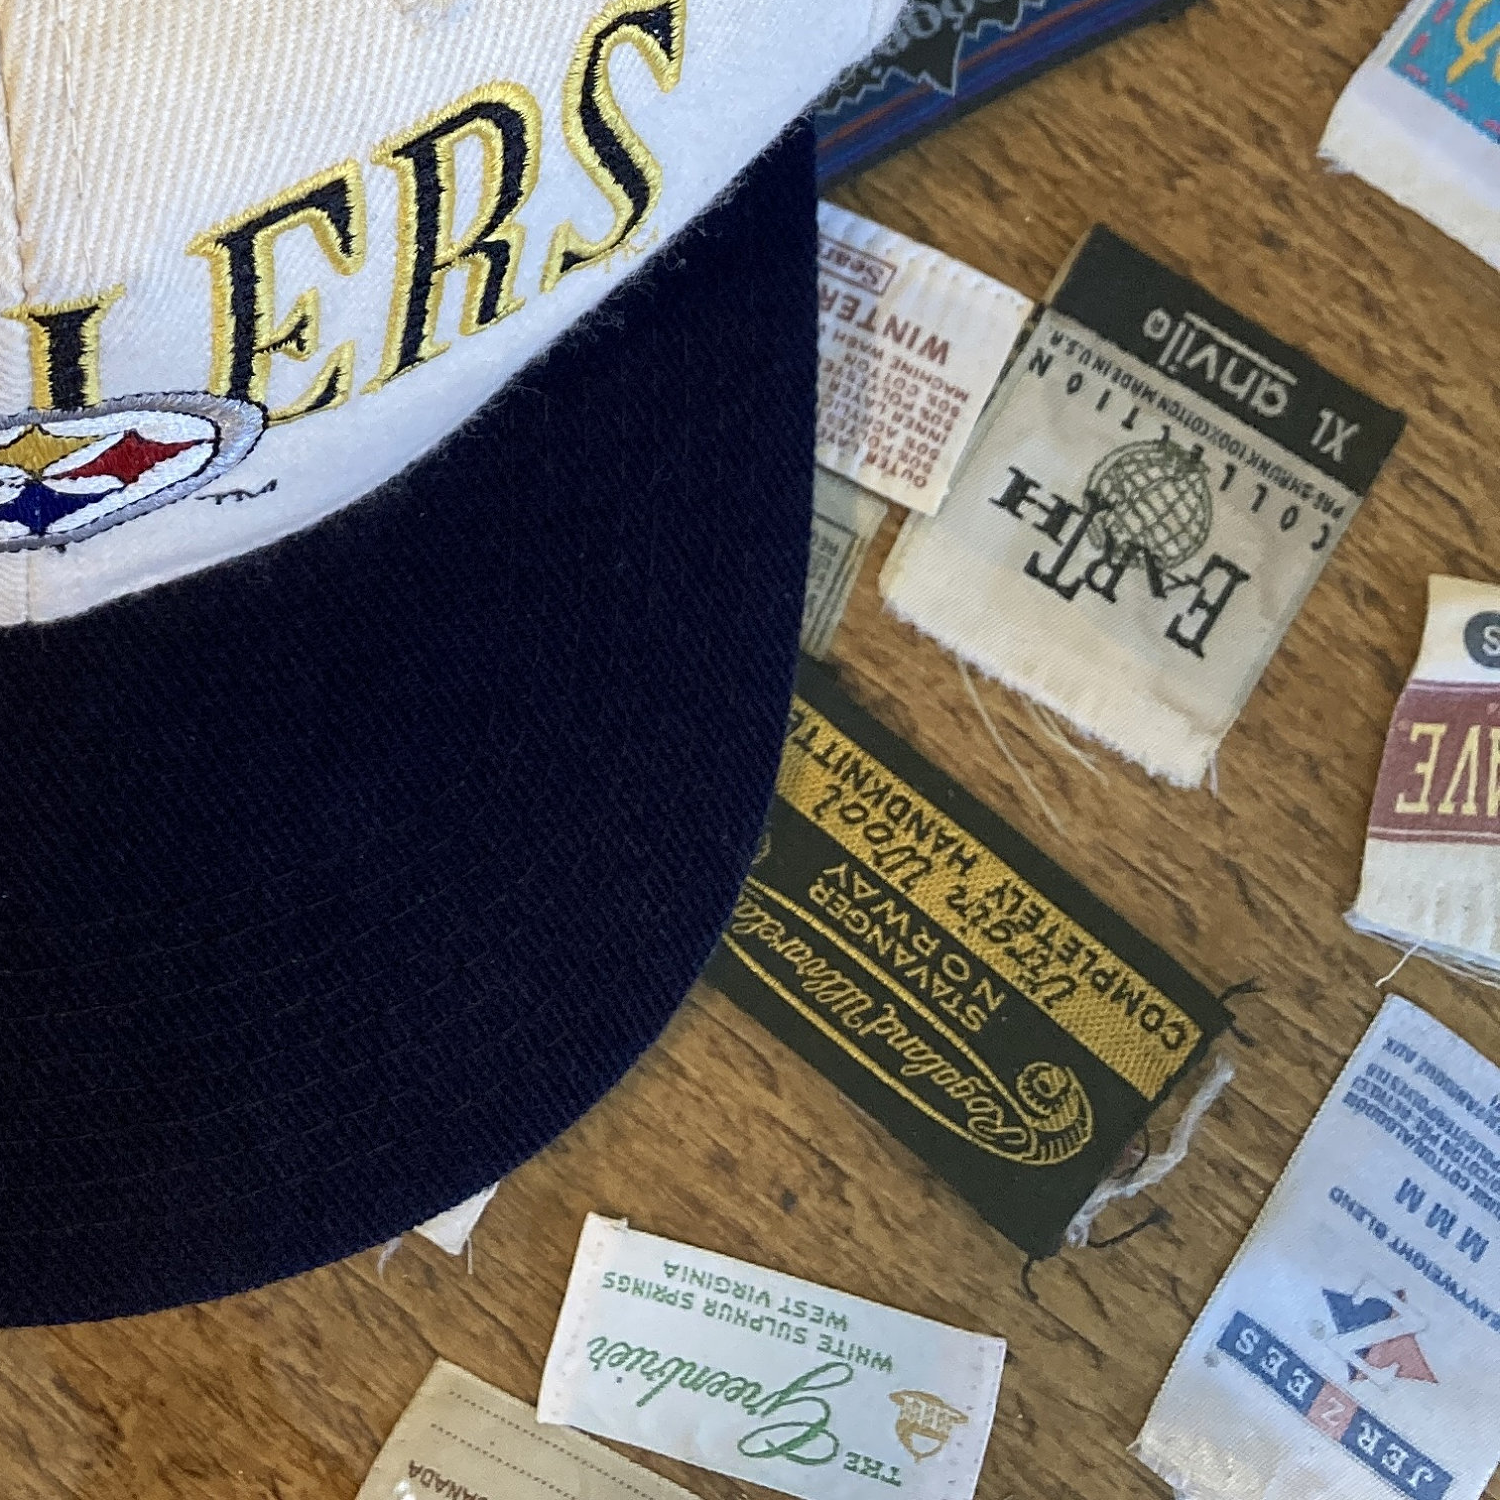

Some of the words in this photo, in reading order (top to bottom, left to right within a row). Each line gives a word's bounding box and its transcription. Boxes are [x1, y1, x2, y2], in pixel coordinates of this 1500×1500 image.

[816, 282, 952, 366] WINTER
[831, 327, 885, 362] WASH
[826, 378, 887, 416] LAYER
[841, 351, 920, 398] COTTON
[888, 354, 970, 403] MACHINE
[1107, 364, 1159, 404] MADE
[1156, 320, 1293, 424] anvil
[889, 410, 948, 445] INNER
[1026, 347, 1334, 553] COLLECTION
[1302, 404, 1361, 464] XL
[862, 449, 929, 490] OUTER
[987, 465, 1253, 659] EARTH
[804, 776, 938, 898] Wool
[804, 872, 991, 1035] STAVANGER
[821, 851, 1009, 1015] NORWAY
[929, 876, 1083, 1015] Virgin
[983, 874, 1191, 1052] COMPLETELY
[857, 1000, 1028, 1136] Rogaland
[1325, 1183, 1391, 1240] BLEND
[1390, 1175, 1429, 1216] M
[1421, 1200, 1461, 1241] M
[1453, 1224, 1493, 1265] M
[600, 1268, 695, 1311] SPRINGS
[659, 1258, 774, 1308] VIRGINIA
[700, 1295, 810, 1345] SULPHUR
[775, 1293, 850, 1332] WEST
[815, 1331, 894, 1373] WHITE
[582, 1331, 853, 1467] Greenbrier
[1230, 1323, 1437, 1495] JERZEES
[404, 1459, 487, 1500] ANADA
[840, 1450, 906, 1488] THE
